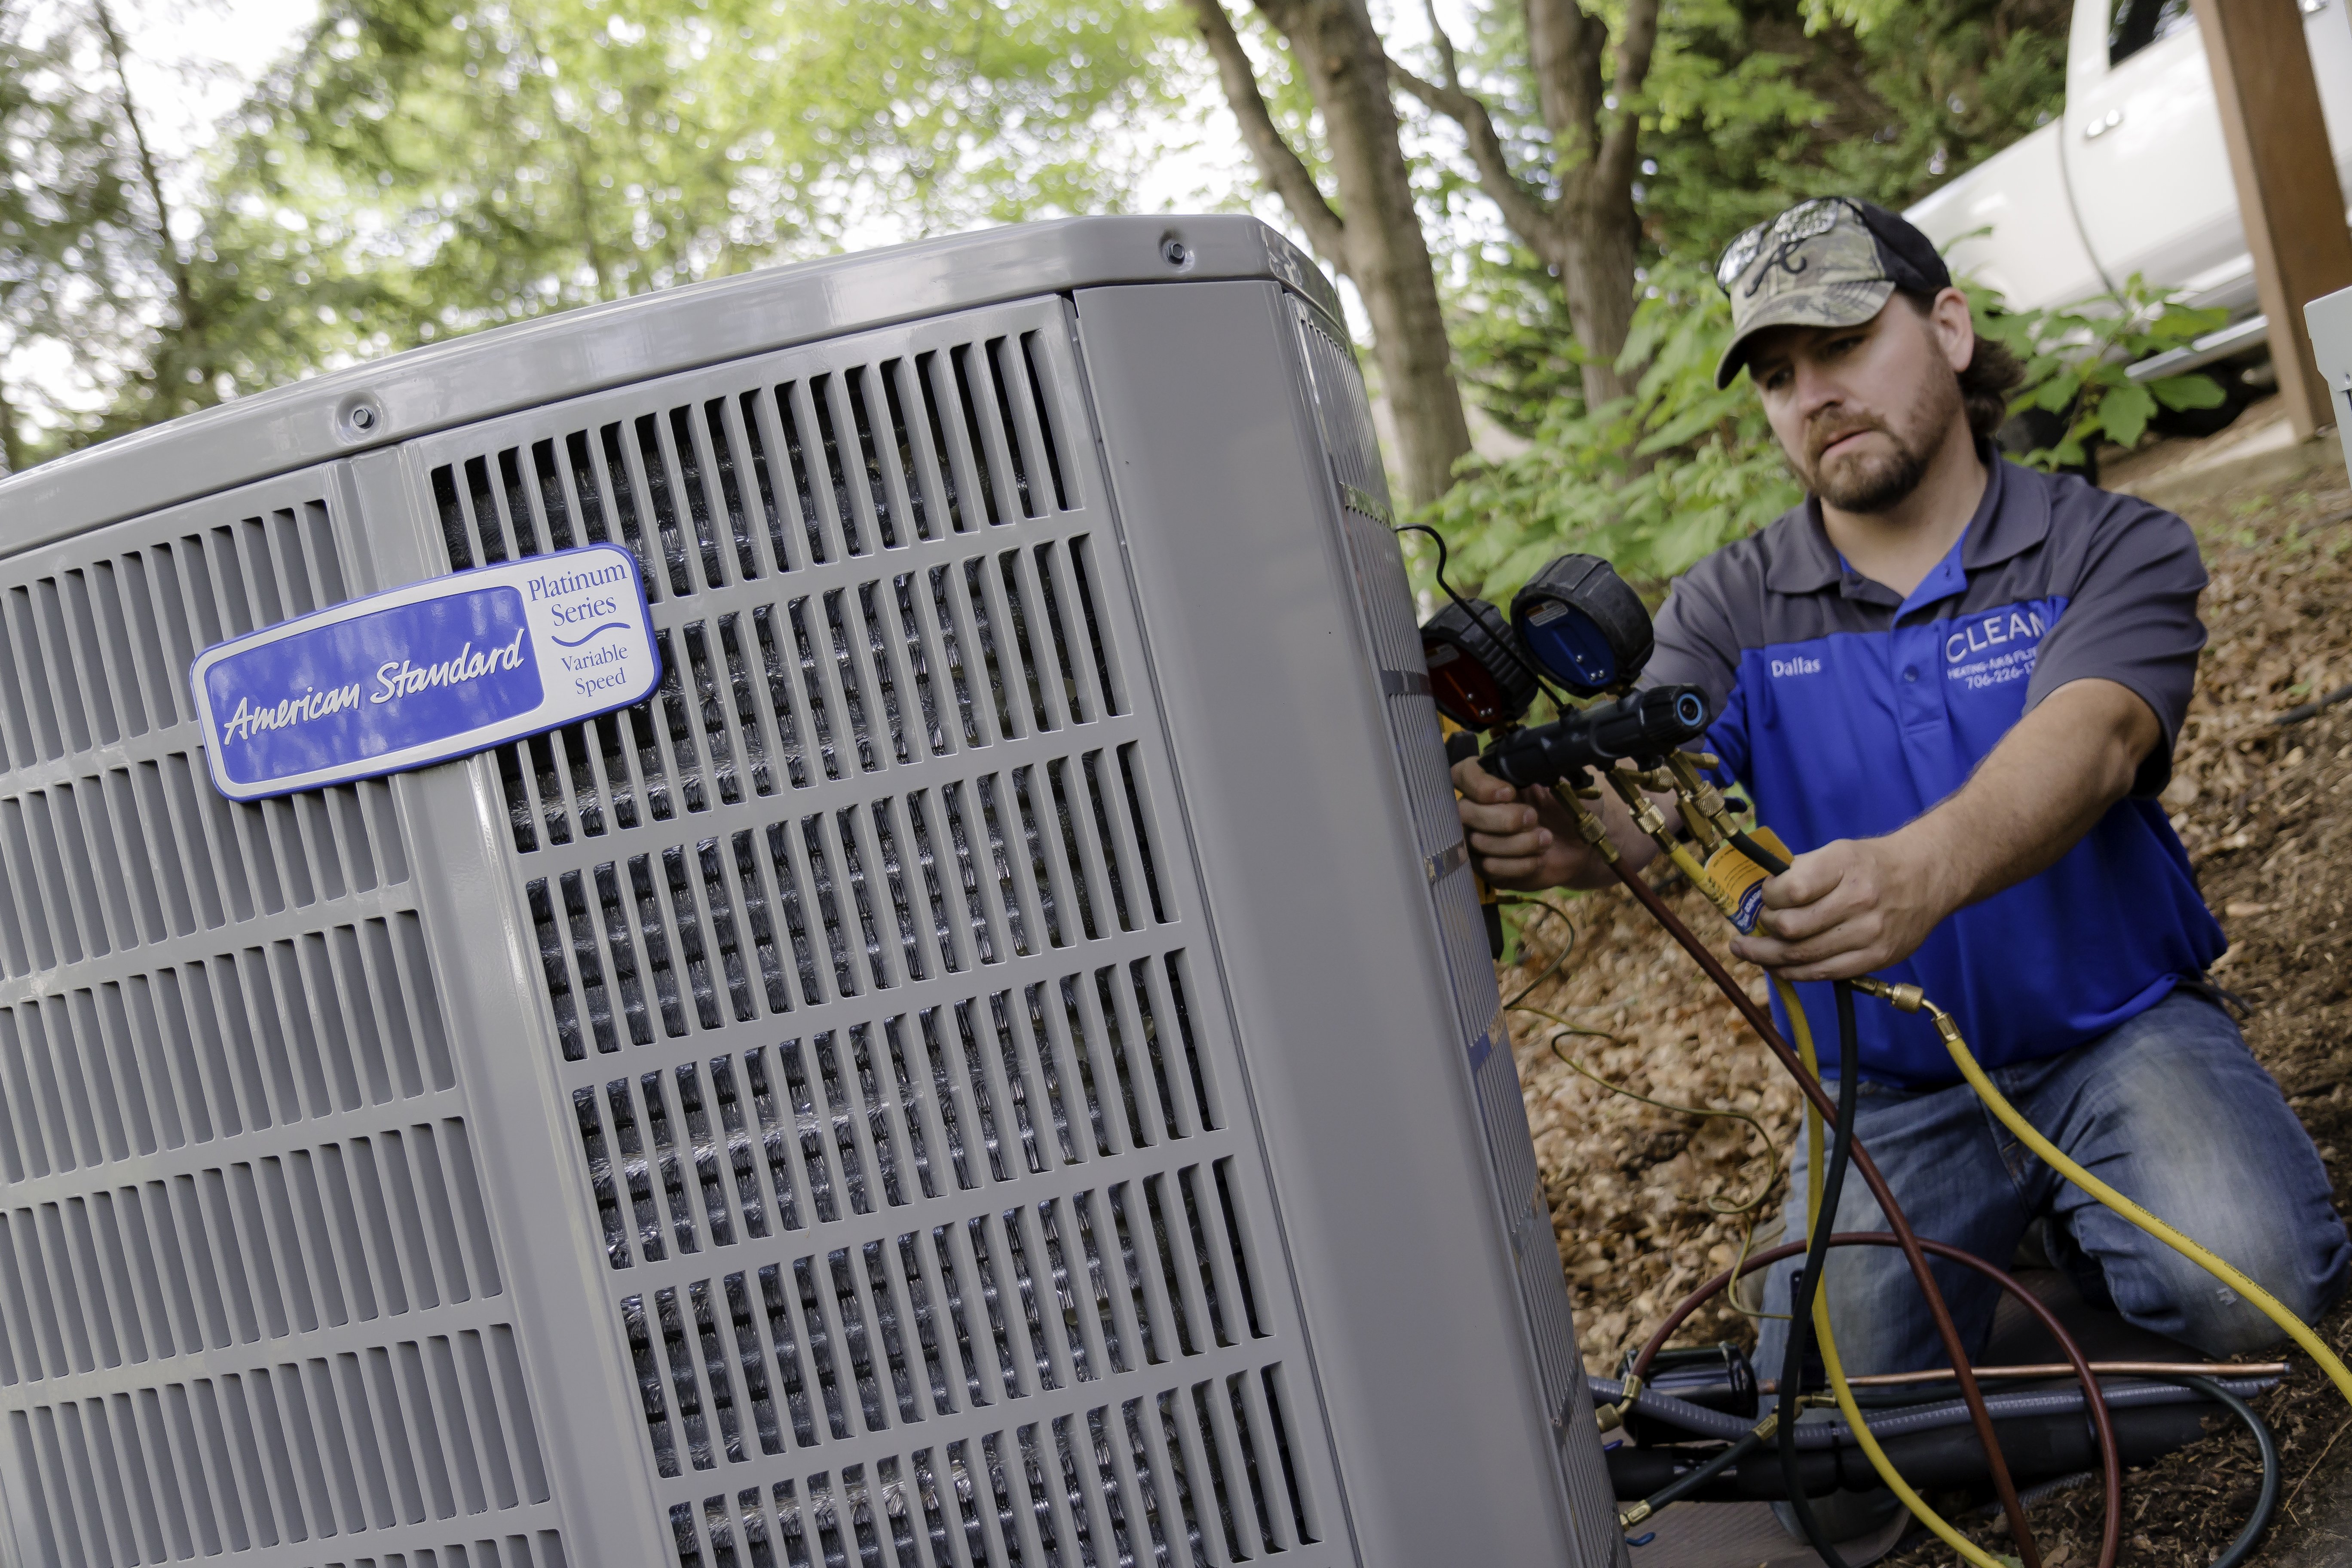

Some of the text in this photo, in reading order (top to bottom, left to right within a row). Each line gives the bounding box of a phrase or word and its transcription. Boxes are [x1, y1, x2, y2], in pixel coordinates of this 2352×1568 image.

[527, 564, 628, 602] Platinum
[551, 597, 617, 627] Series
[560, 644, 628, 671] Variable
[1771, 656, 1821, 678] Dallas
[224, 628, 525, 746] American Standard
[575, 667, 627, 698] Speed
